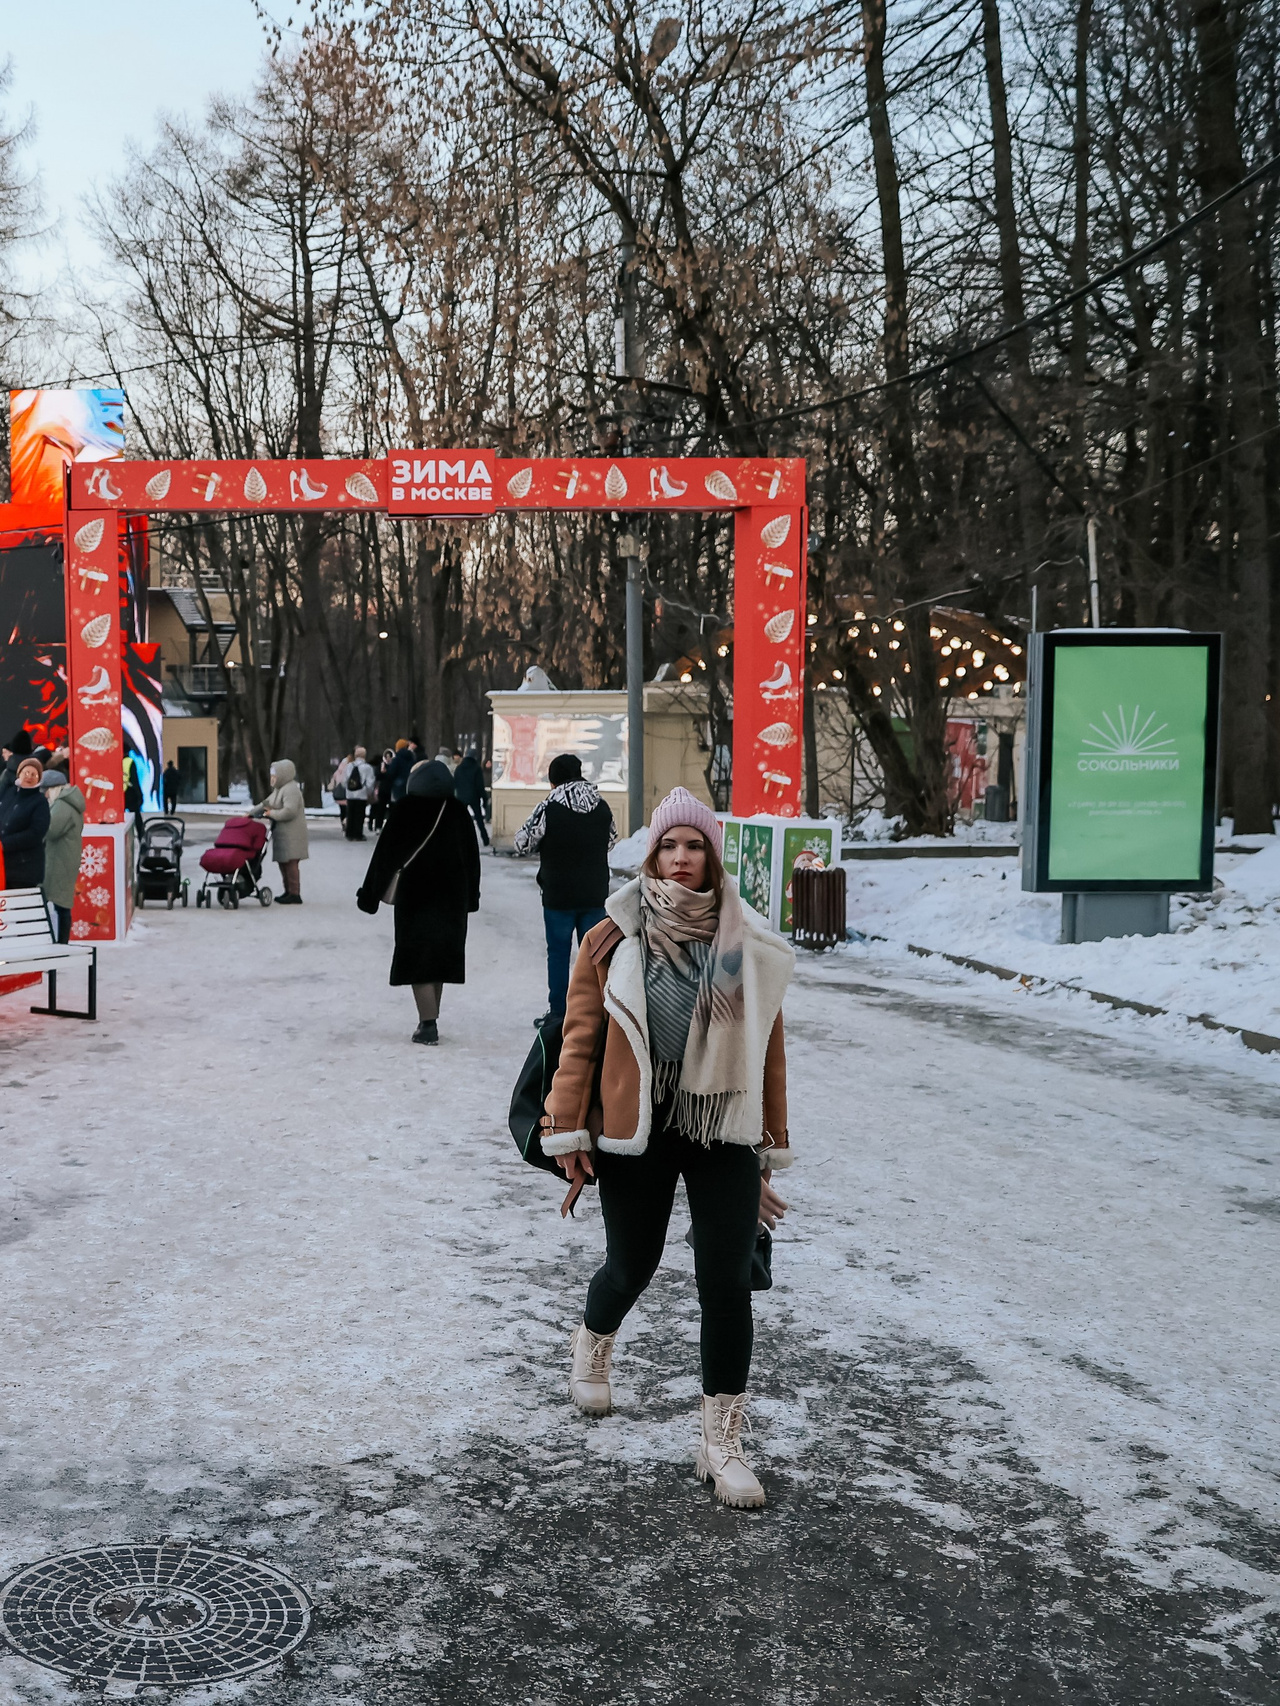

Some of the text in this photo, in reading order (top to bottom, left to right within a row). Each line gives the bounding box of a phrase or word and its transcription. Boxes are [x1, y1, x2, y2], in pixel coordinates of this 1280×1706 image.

[391, 460, 492, 484] ЗИМА
[392, 487, 493, 501] В МОСКВЕ
[1077, 759, 1179, 772] СОКОЛЬНИКИ
